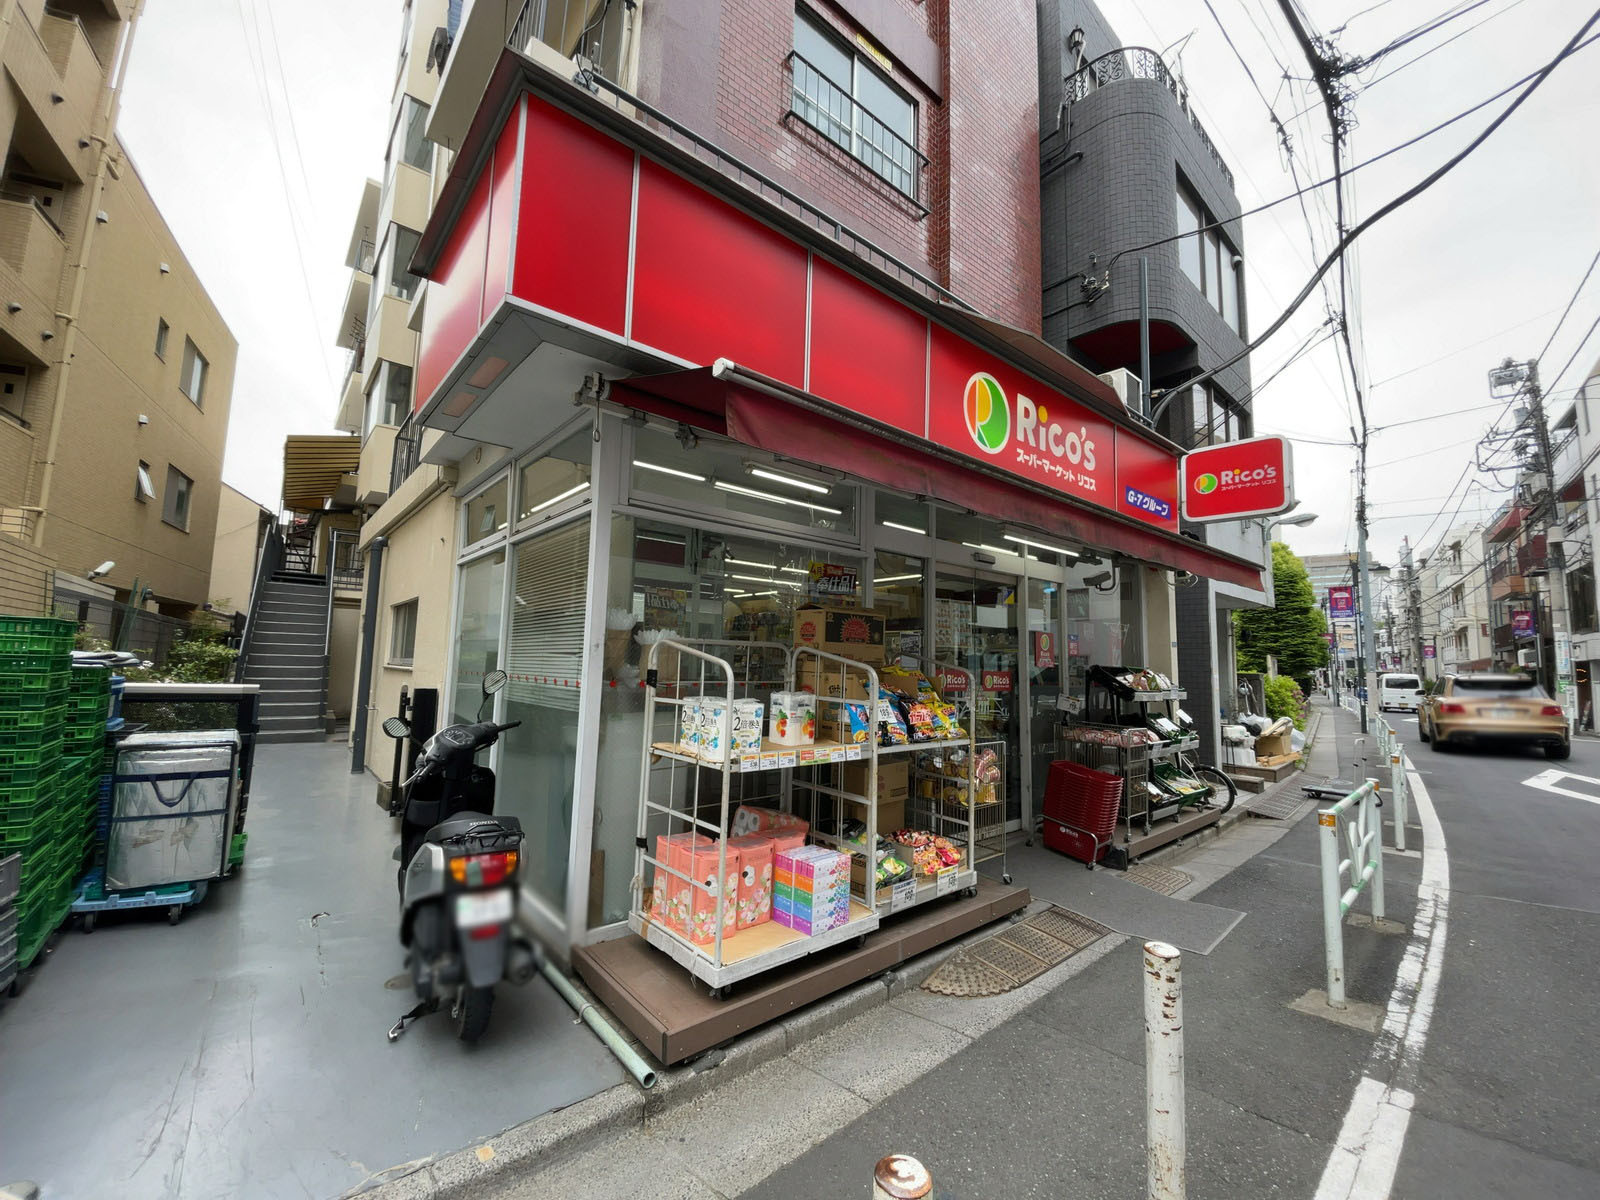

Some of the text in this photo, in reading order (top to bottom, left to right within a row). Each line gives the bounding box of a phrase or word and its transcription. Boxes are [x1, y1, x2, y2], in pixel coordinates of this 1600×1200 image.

[1016, 392, 1096, 471] Rico's
[1016, 447, 1096, 492] スーパーマーケット リコス
[1220, 464, 1276, 485] Rico's
[946, 675, 966, 684] Rico's
[993, 675, 1010, 685] Rico's
